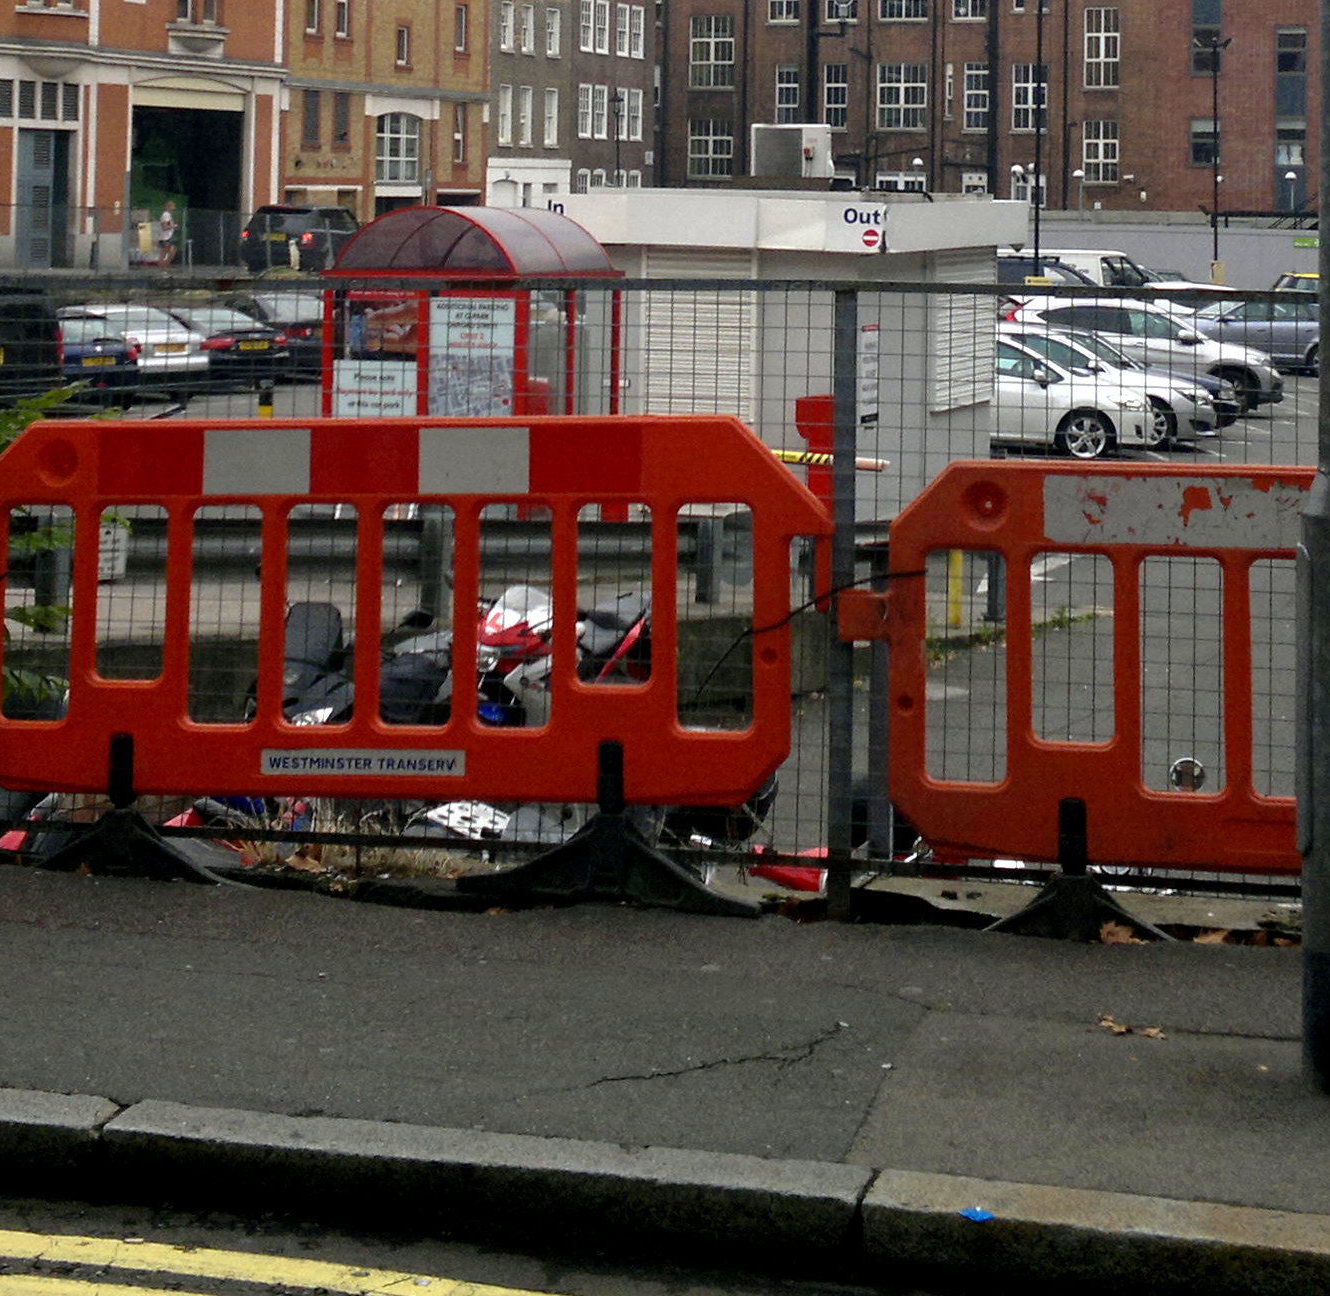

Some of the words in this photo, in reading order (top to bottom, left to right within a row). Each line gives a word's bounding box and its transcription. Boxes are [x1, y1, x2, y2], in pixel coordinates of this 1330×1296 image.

[548, 199, 564, 215] In
[843, 207, 881, 225] Out
[269, 757, 372, 771] WESTMINSTER
[377, 758, 455, 772] TRANSERV
